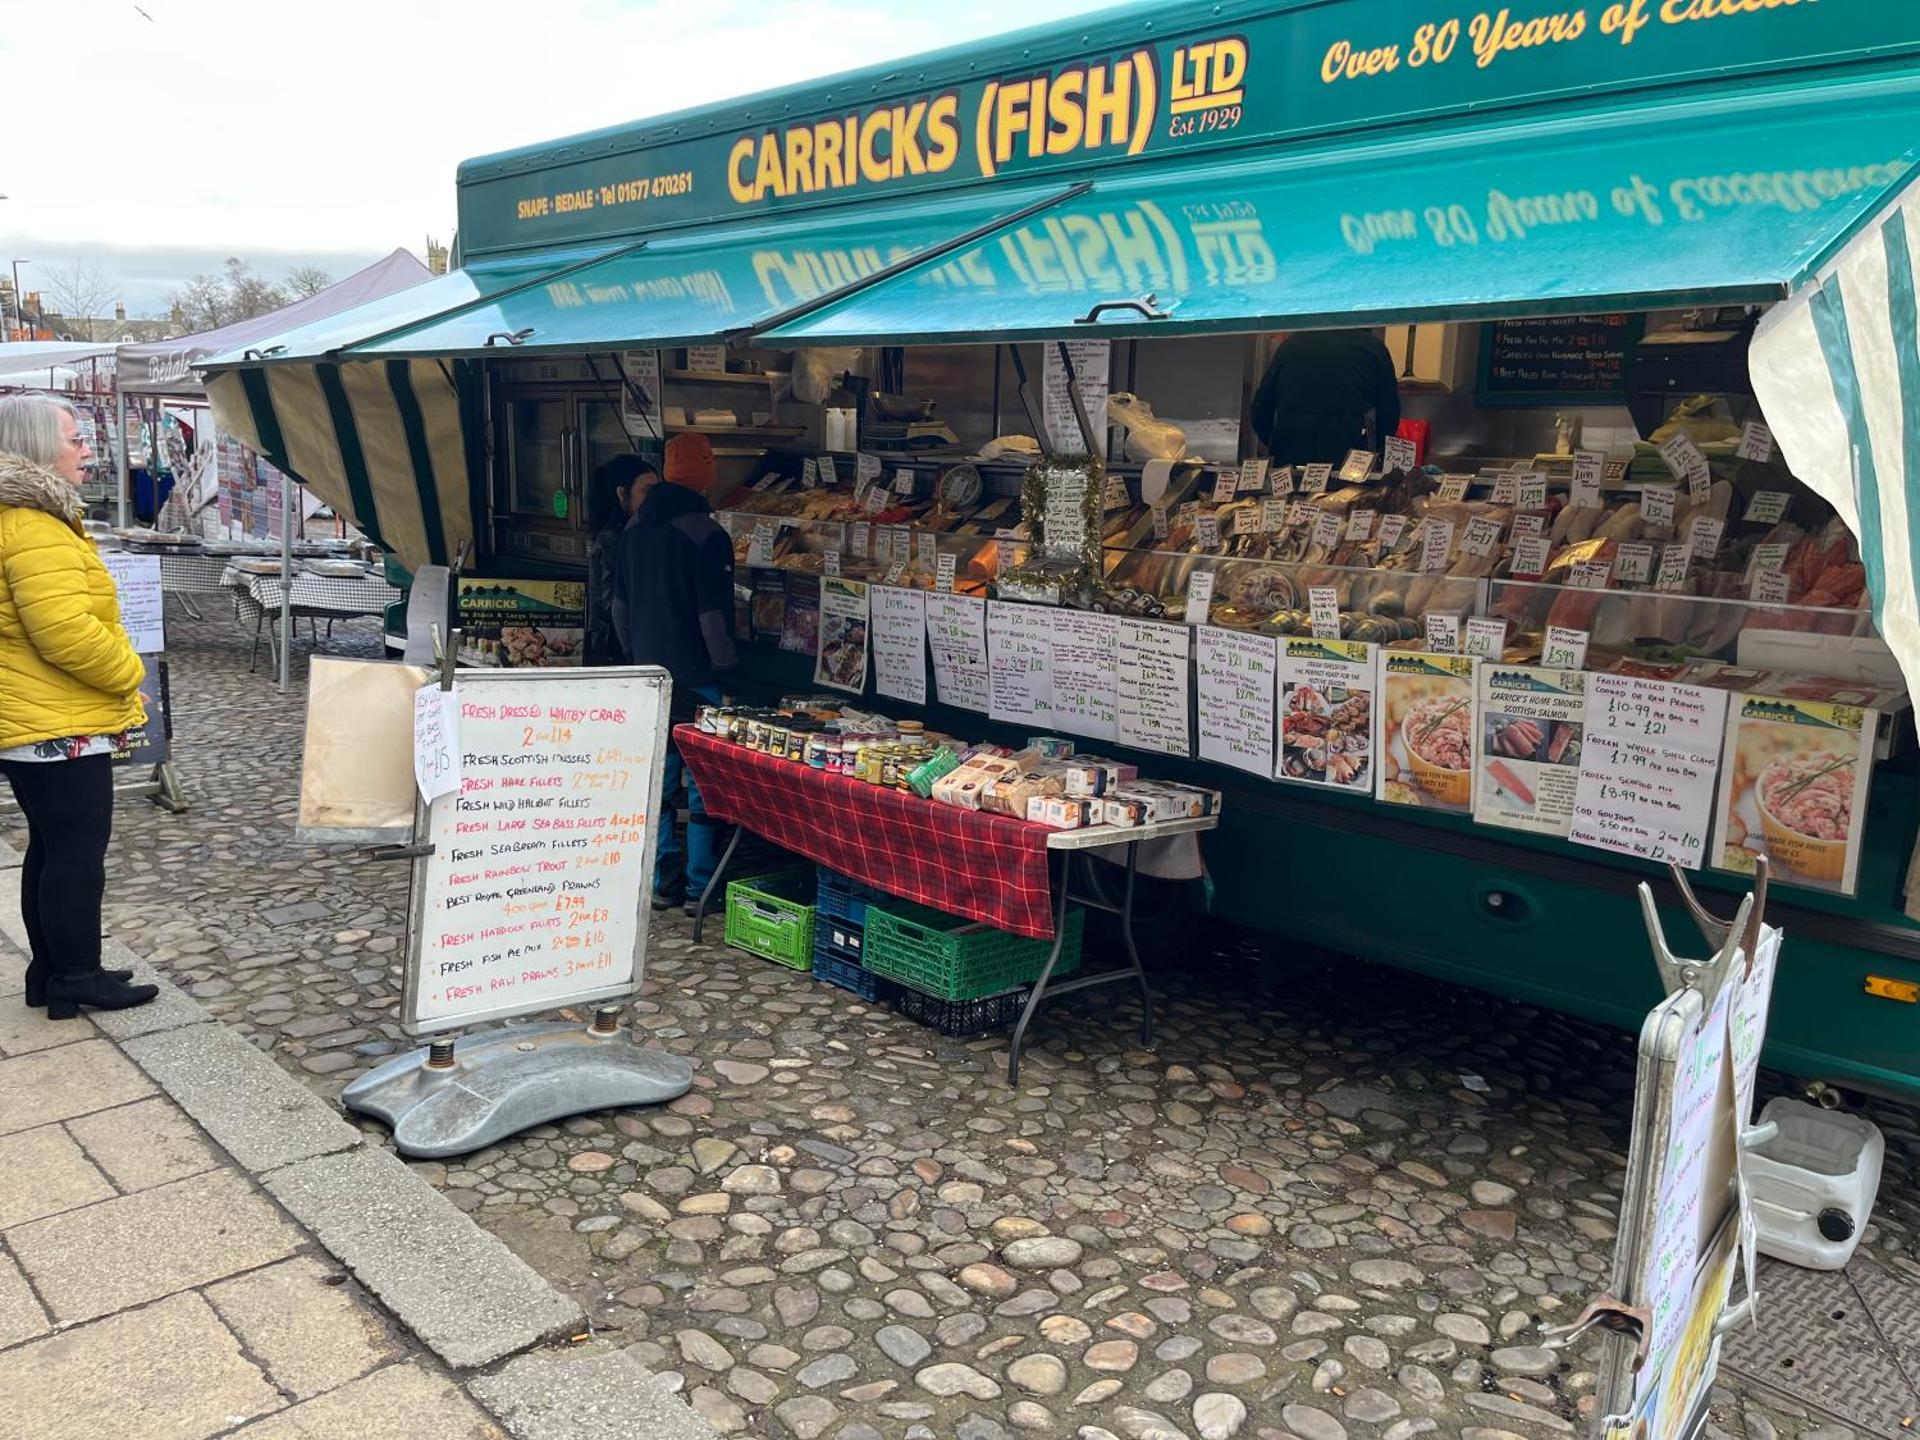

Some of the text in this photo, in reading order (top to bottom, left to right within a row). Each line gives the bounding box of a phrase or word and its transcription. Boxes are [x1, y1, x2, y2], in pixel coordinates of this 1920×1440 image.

[1320, 40, 1400, 84] Over
[1408, 24, 1459, 67] 80
[1468, 3, 1586, 67] Years
[1599, 0, 1649, 45] of
[727, 39, 1246, 204] CARRICKS (FISH) LTD
[1169, 105, 1242, 138] Est 1929
[518, 172, 692, 219] SNAPE BEDALE Tel 01677 470261
[460, 599, 517, 608] CARRICKS
[1596, 676, 1701, 698] FROZEN PEELED TIGER
[1491, 692, 1582, 709] CARRICK'S HOME SMOKED
[1608, 699, 1650, 717] £10.99
[1649, 694, 1665, 703] RAW
[1670, 697, 1706, 712] PRAWNS
[462, 704, 496, 718] FRESH
[550, 706, 585, 723] WHITBY
[589, 709, 626, 723] CRABS
[1504, 705, 1568, 719] SCOTTISH SALMON
[1608, 716, 1617, 727] 2
[1644, 721, 1666, 735] £21
[522, 727, 535, 747] 2
[1586, 734, 1619, 748] FROZEN
[1626, 743, 1656, 755] WHOLE
[462, 753, 499, 768] FRESH
[501, 754, 548, 765] SCOTTISH
[552, 754, 591, 764] MUSSELS
[460, 778, 494, 795] FRESH
[501, 776, 526, 788] HAKE
[529, 778, 564, 787] FILLETS
[1580, 771, 1612, 781] FROZEN
[1600, 785, 1636, 800] £8.99
[456, 798, 591, 811] FRESH WILD HALIBUT FILLETS
[1575, 807, 1636, 823] COD GOUJONS
[456, 823, 489, 835] FRESH
[499, 821, 527, 831] LARGE
[532, 819, 550, 831] SEA
[552, 818, 574, 829] BASS
[576, 818, 606, 827] FILLETS
[1658, 831, 1666, 840] 2
[1680, 832, 1699, 848] £10
[451, 849, 483, 863] FRESH
[552, 839, 588, 849] FILLETS
[449, 871, 479, 886] FRESH
[485, 866, 530, 879] RAINBOW
[538, 861, 568, 873] TROUT
[446, 896, 472, 909] BEST
[506, 883, 556, 899] GREENLAND
[562, 878, 601, 891] PRAWNS
[555, 895, 585, 912] £7.99
[441, 933, 474, 948] FRESH
[480, 924, 524, 939] HADDOCK
[530, 917, 562, 930] FILLETS
[440, 960, 473, 978] FRESH
[482, 953, 502, 965] FISH
[507, 949, 520, 959] PIE
[525, 943, 541, 954] MIX
[446, 986, 482, 1001] FRESH
[490, 978, 516, 991] RAW
[522, 967, 559, 984] PRAWNS
